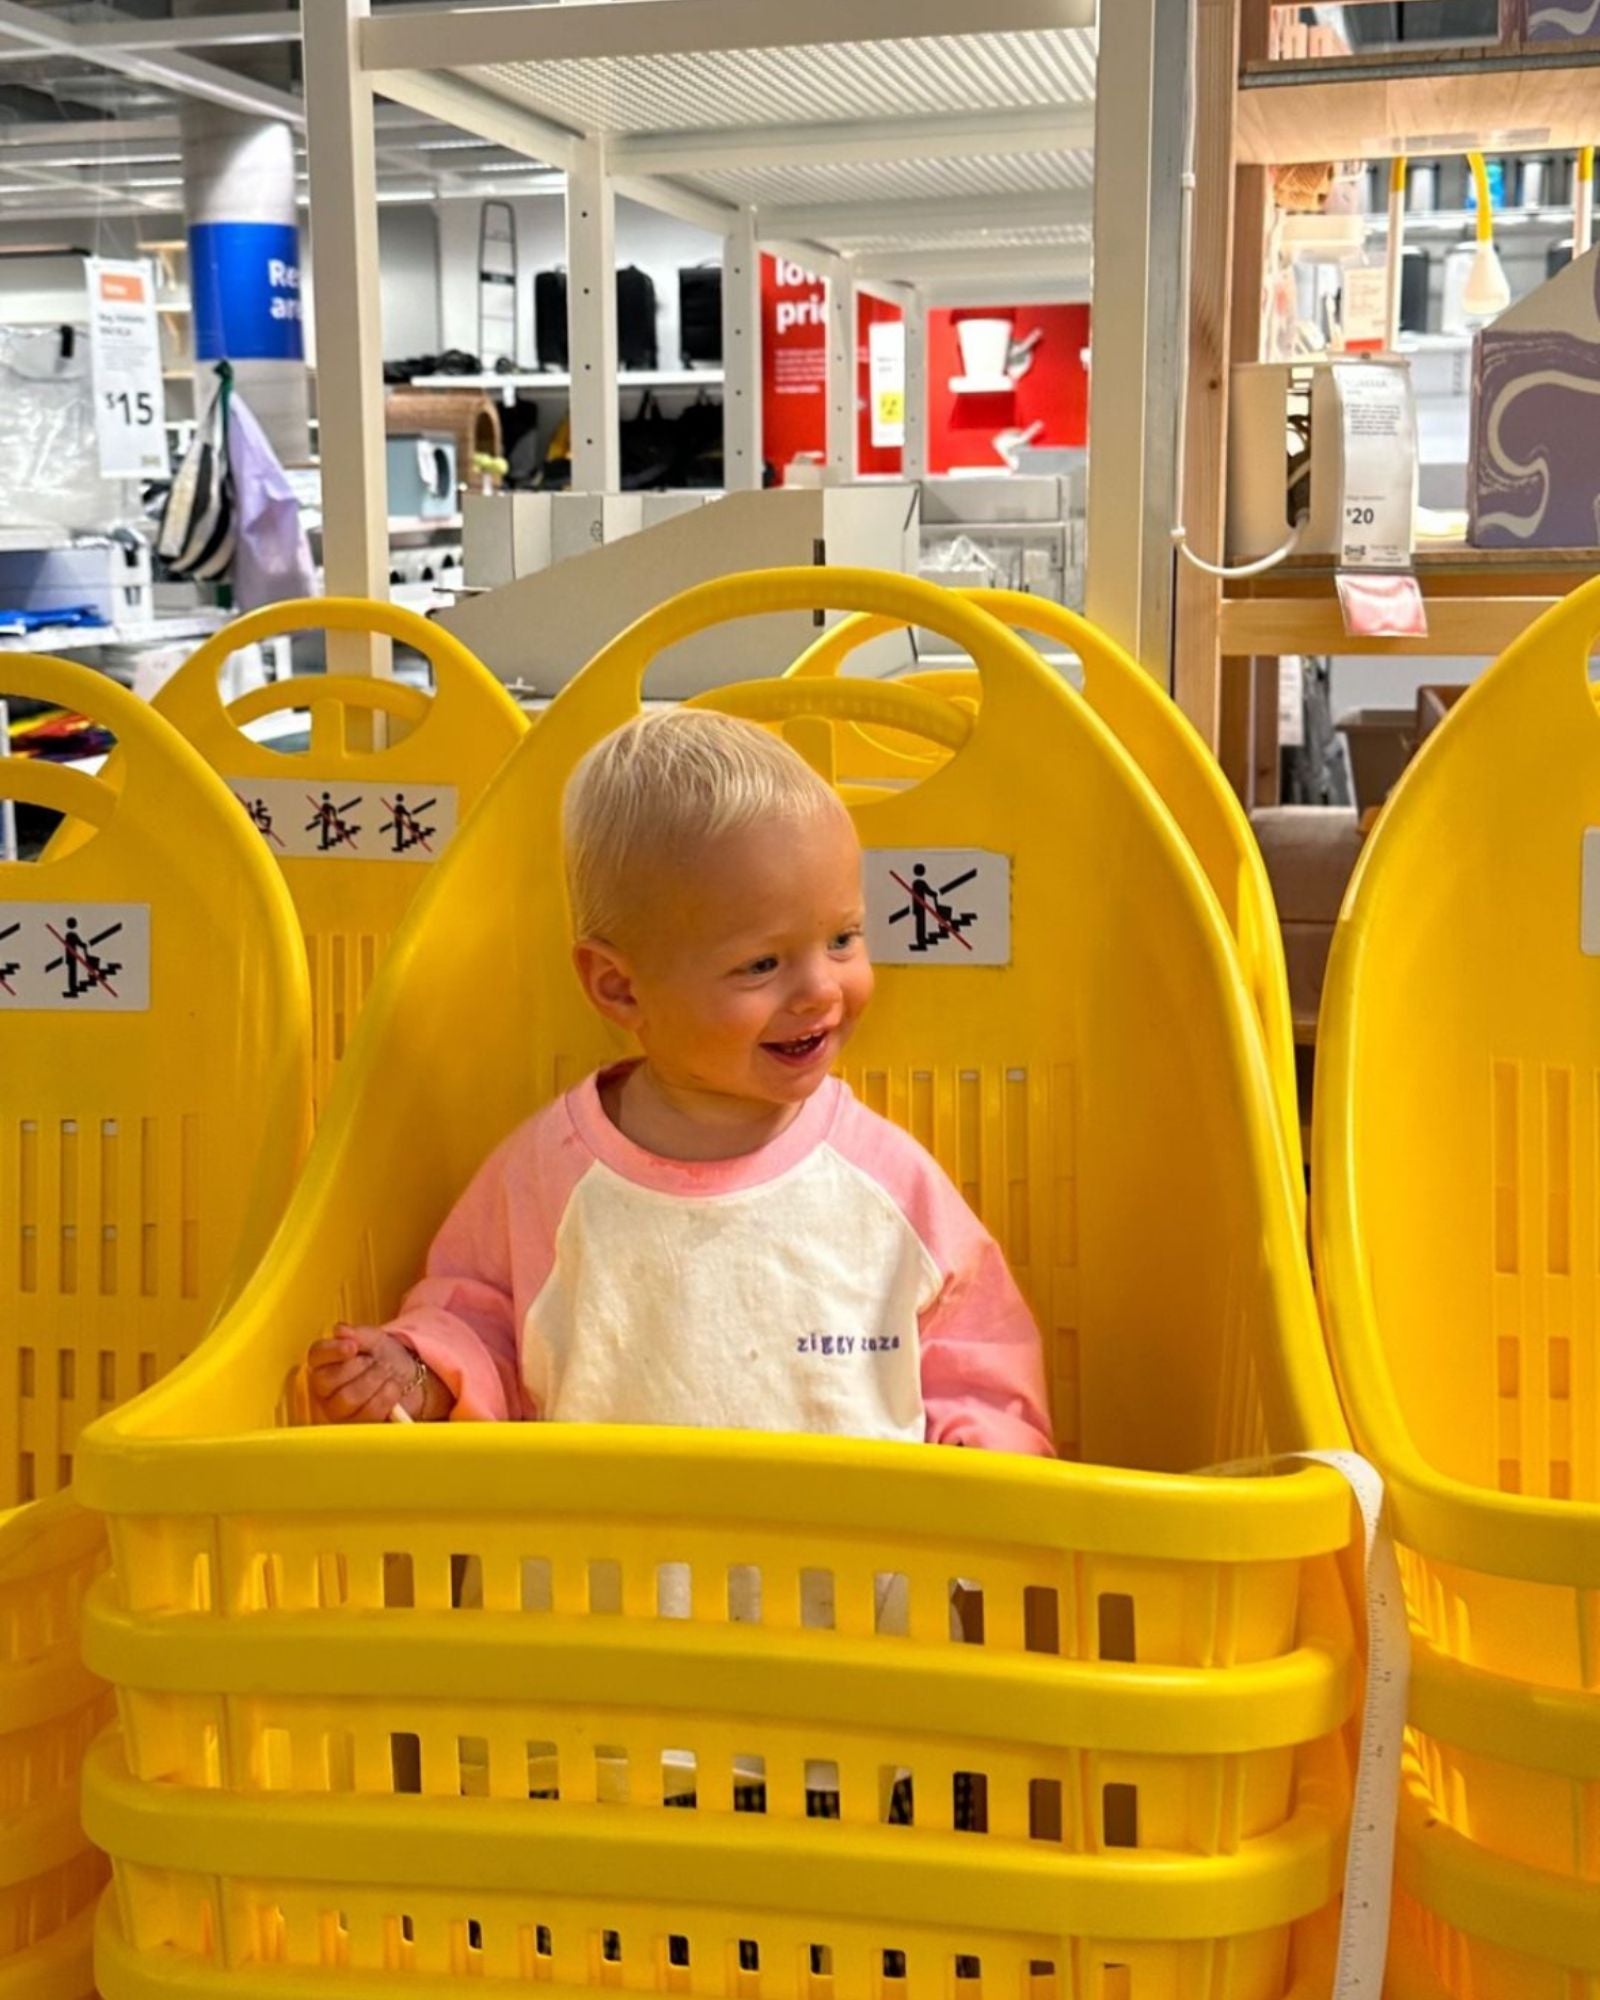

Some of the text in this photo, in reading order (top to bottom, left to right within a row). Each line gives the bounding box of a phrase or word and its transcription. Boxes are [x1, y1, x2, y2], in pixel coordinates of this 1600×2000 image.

[105, 391, 153, 426] $15
[1346, 507, 1375, 525] $20
[797, 1333, 854, 1355] ziggy
